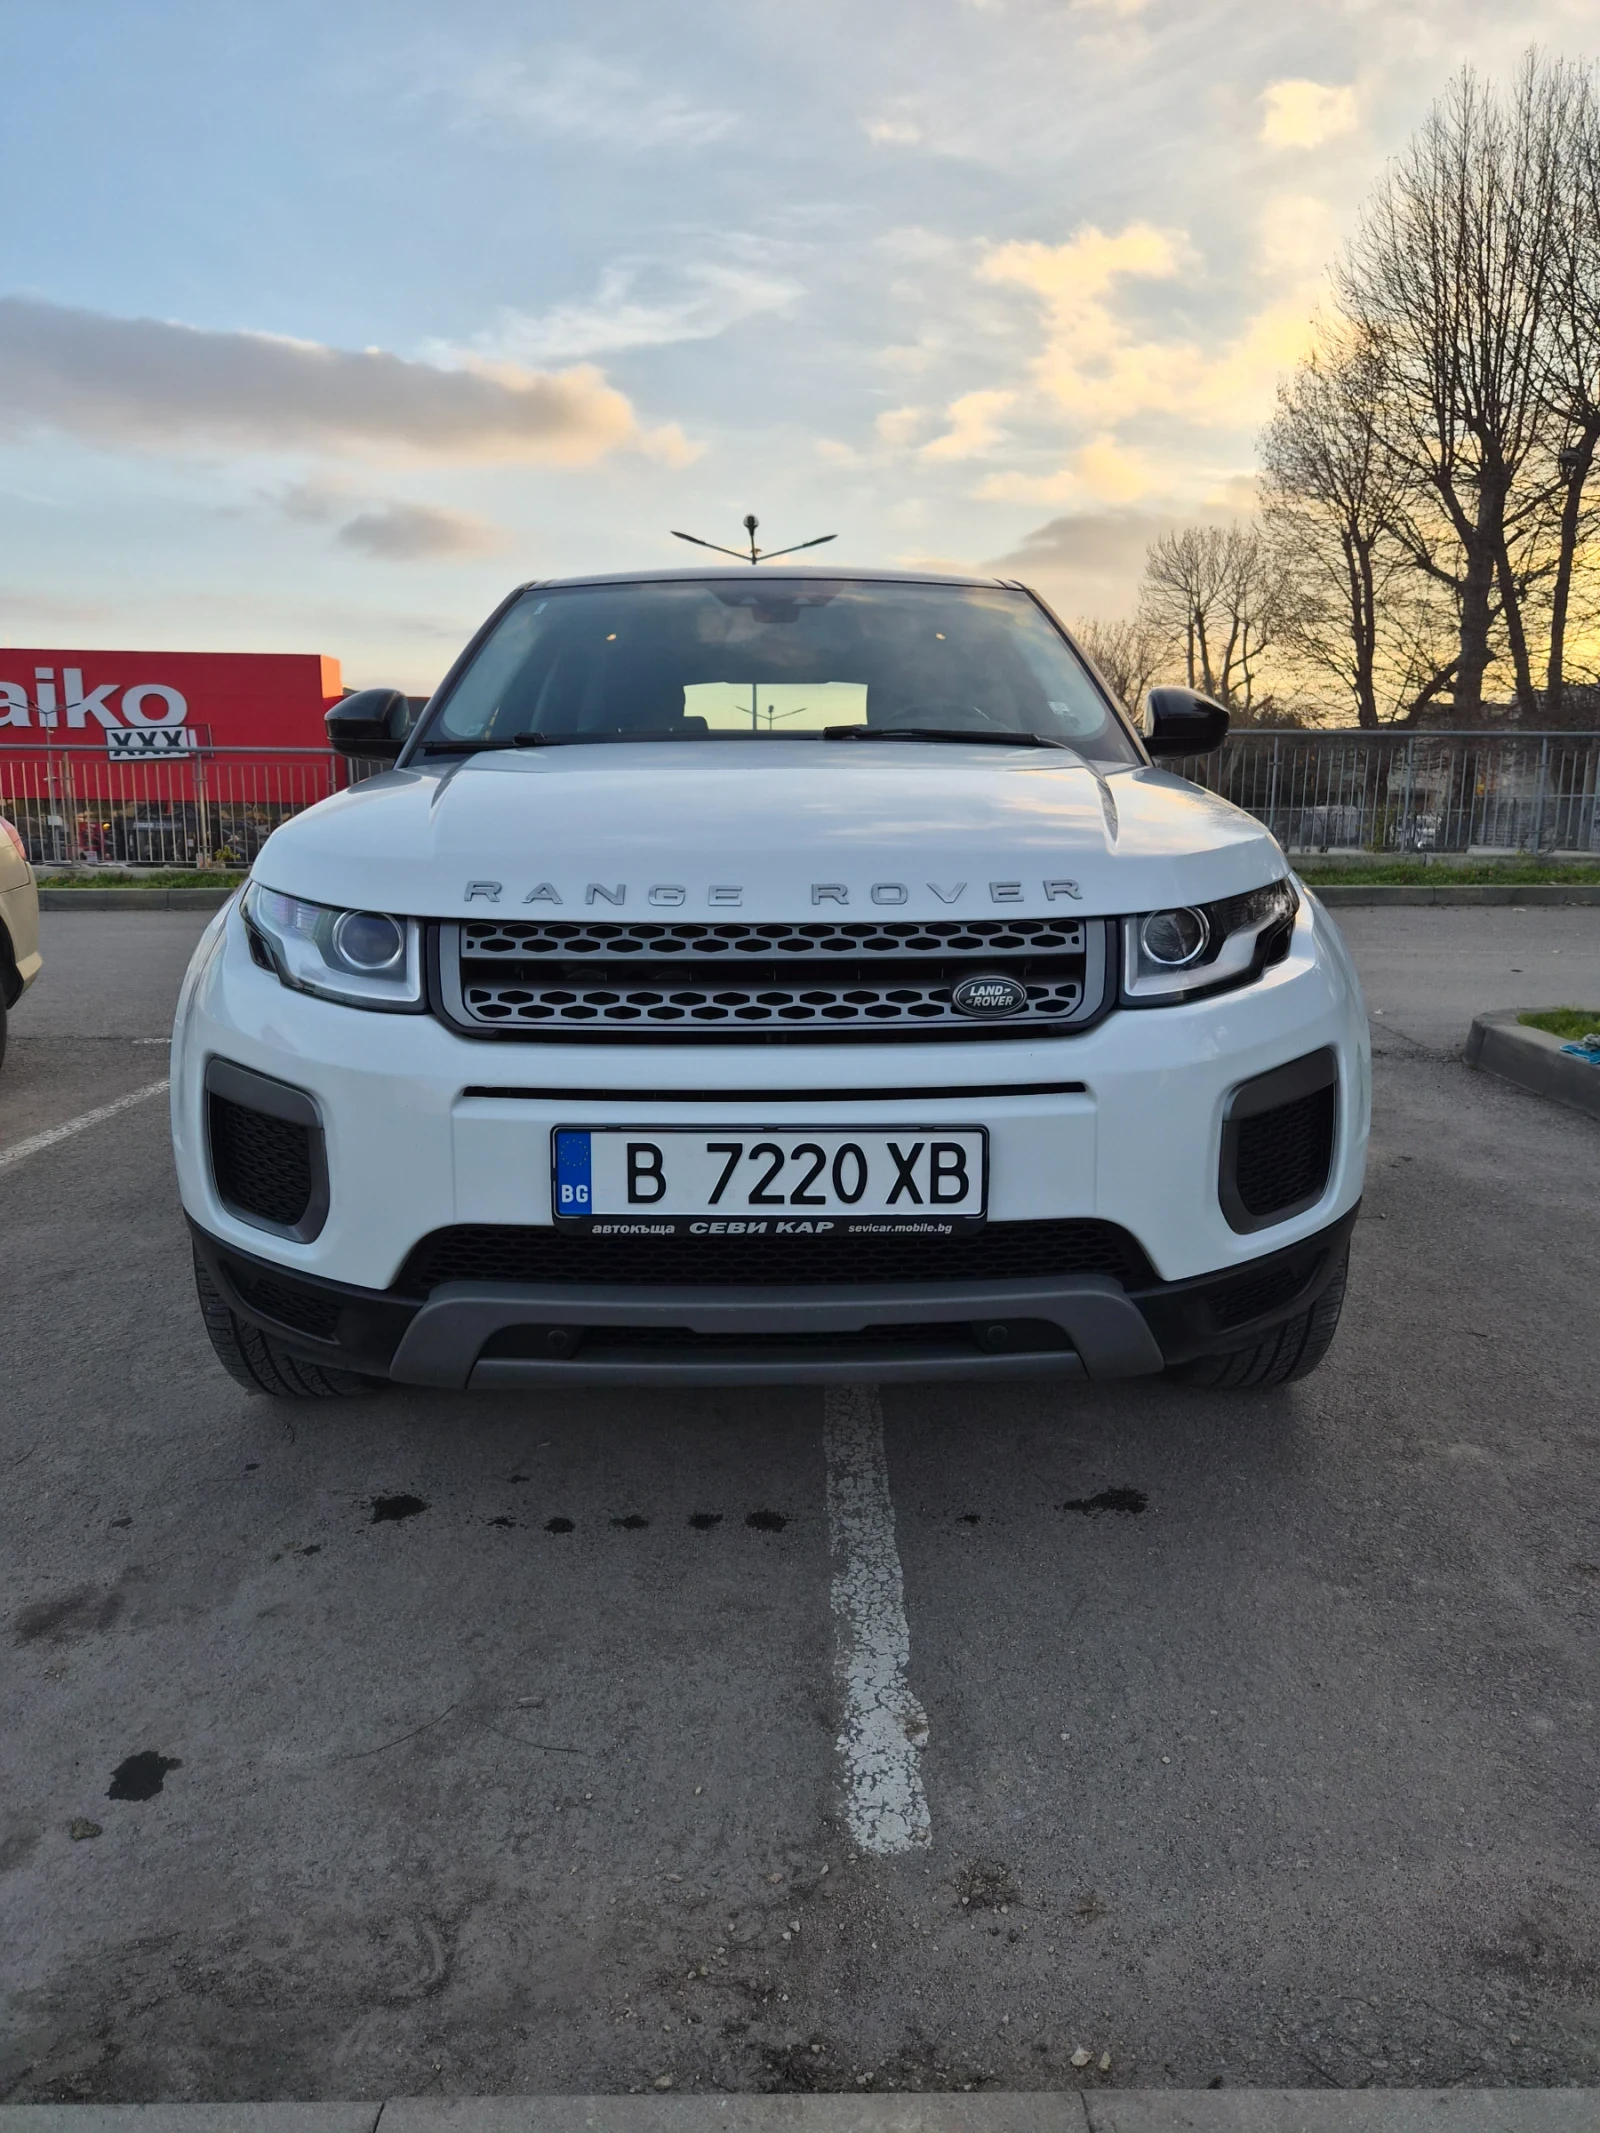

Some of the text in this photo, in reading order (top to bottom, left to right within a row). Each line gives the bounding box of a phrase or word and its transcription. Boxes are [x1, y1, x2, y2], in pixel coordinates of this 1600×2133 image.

[464, 879, 1083, 906] RANGE ROVER
[627, 1142, 970, 1205] B 7220 XB
[561, 1184, 589, 1203] BG
[592, 1221, 953, 1234] автокъща СЕВИ КАР sevicar.mobile.bg
